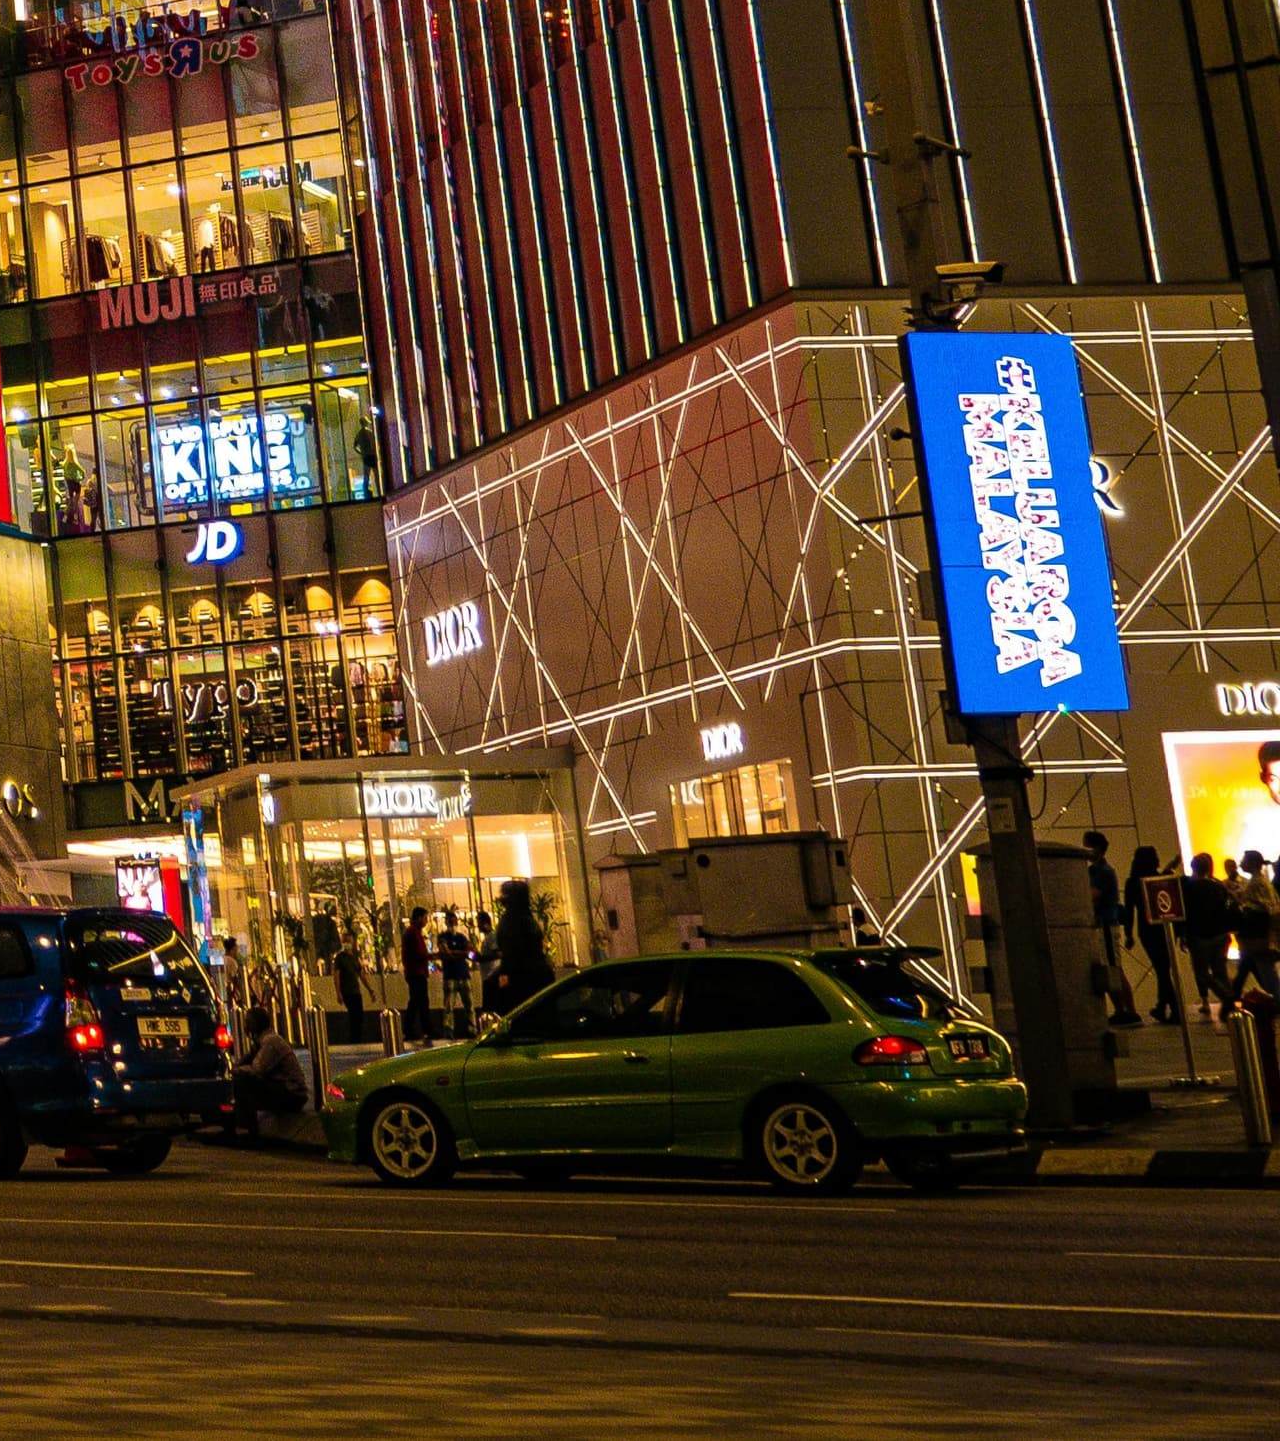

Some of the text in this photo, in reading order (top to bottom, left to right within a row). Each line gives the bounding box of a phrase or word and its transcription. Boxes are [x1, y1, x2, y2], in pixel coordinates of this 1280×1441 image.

[98, 274, 278, 330] MUJI 無印良品
[186, 521, 239, 563] JD
[958, 393, 1040, 676] MALAYSIA
[996, 355, 1082, 689] #KELUARGA
[421, 600, 484, 666] DIOR
[153, 677, 258, 724] Typo
[700, 722, 744, 761] DIOR
[356, 782, 437, 816] DIOR
